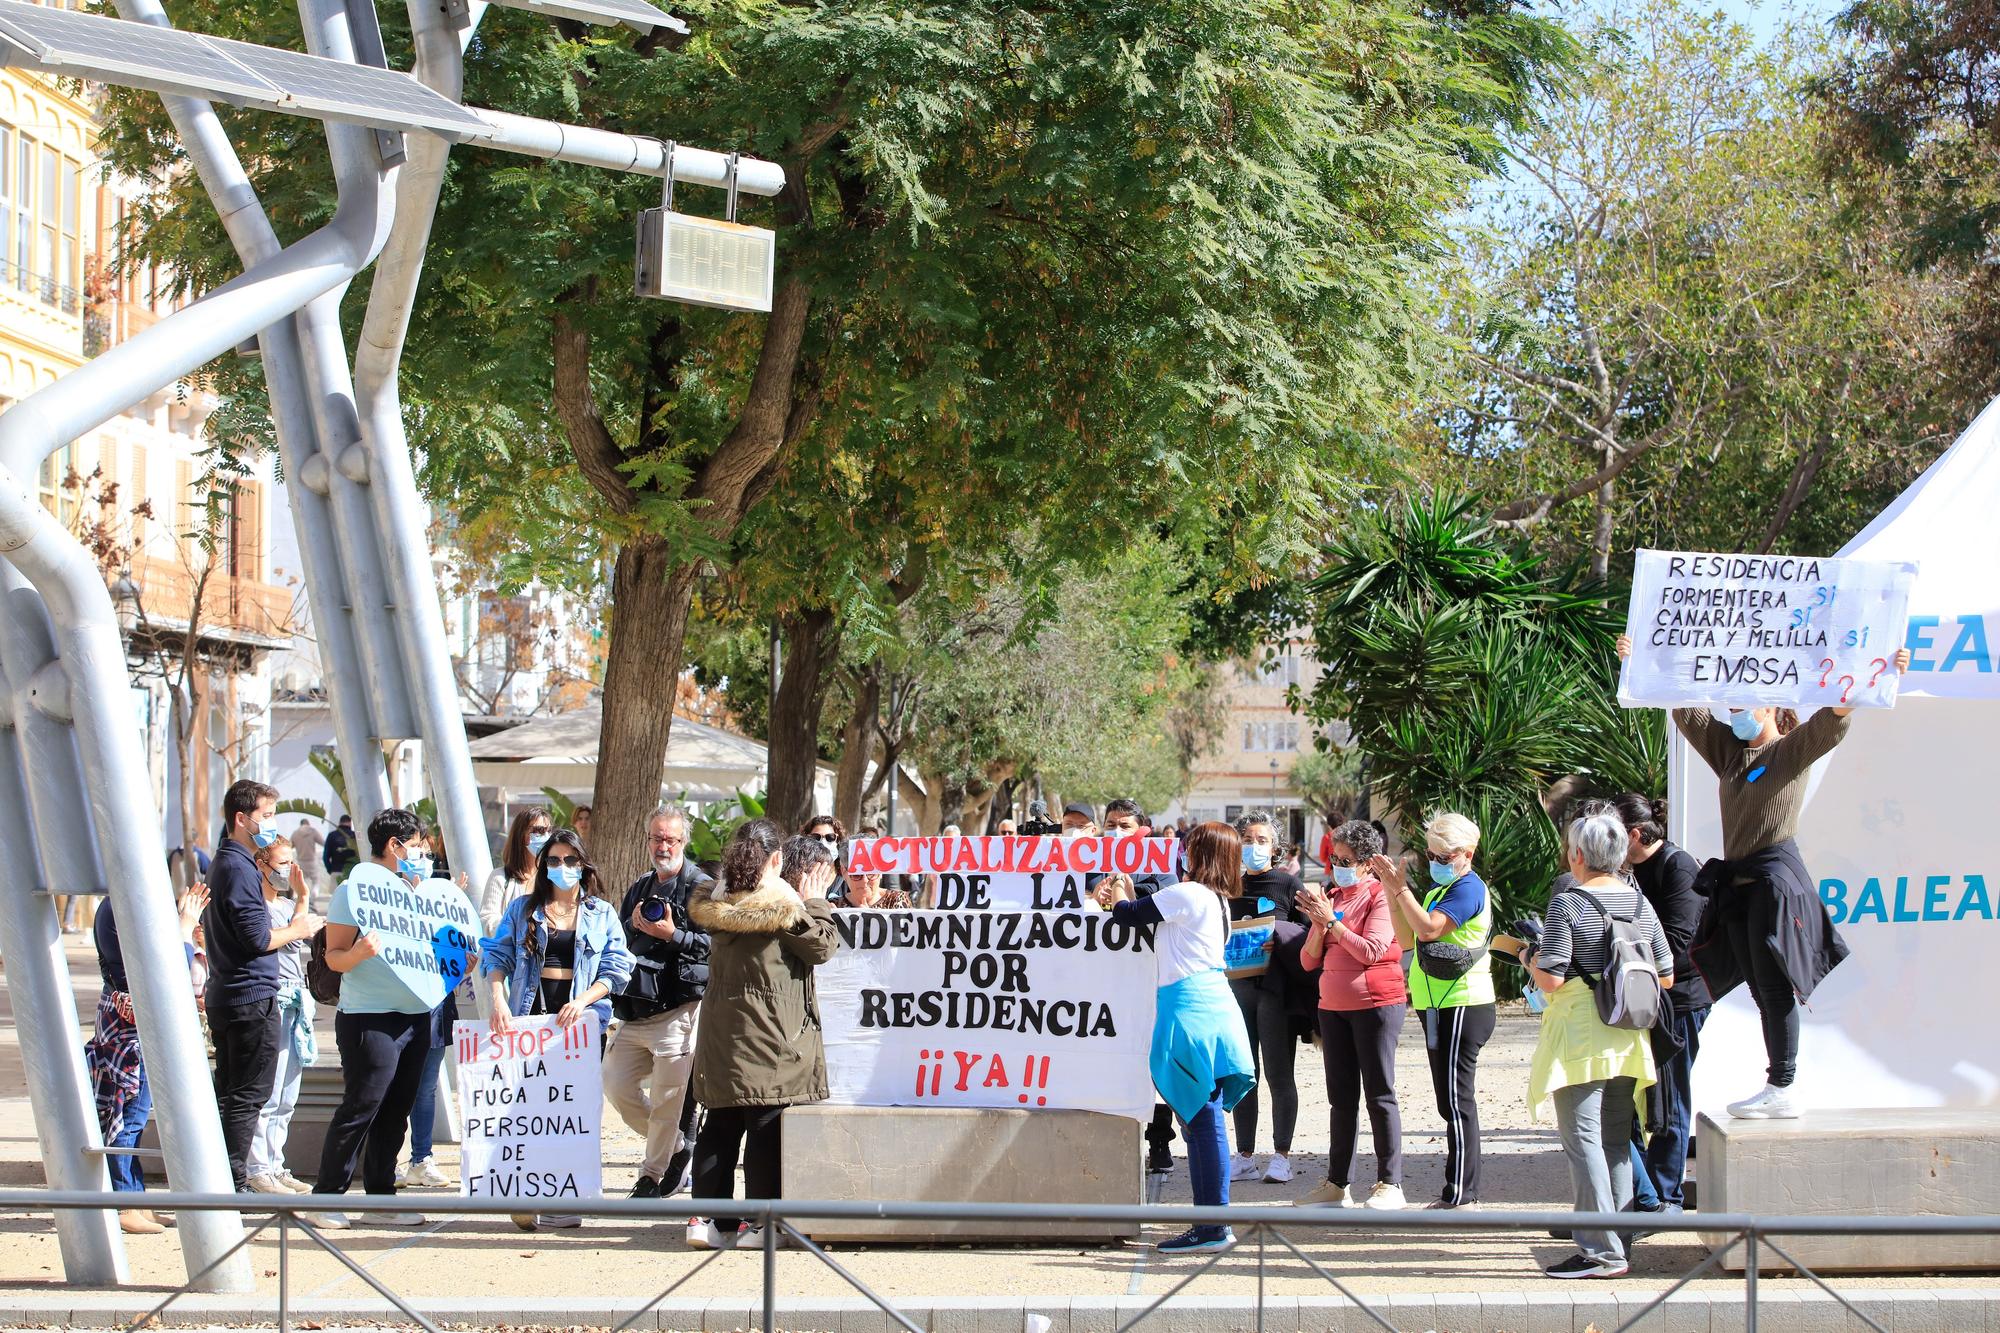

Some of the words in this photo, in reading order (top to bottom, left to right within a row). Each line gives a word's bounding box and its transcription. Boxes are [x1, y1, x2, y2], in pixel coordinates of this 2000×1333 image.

[1668, 556, 1821, 582] RESIDENCIA
[1661, 587, 1788, 608] FORMENTERA
[1651, 628, 1715, 648] CEUTA
[1726, 630, 1738, 648] Y
[1904, 614, 2000, 673] EA
[849, 826, 1172, 874] ACTUALIZACIÓN
[937, 874, 992, 911] DE
[1030, 872, 1082, 910] LA
[1816, 874, 2000, 924] BALEA
[447, 929, 478, 953] CON
[832, 911, 1157, 953] NDEMNIZACION
[941, 951, 1030, 993] POR
[860, 989, 1117, 1038] RESIDENCIA
[489, 1027, 554, 1060] STOP
[491, 1064, 503, 1081] A
[523, 1060, 547, 1079] LA
[474, 1087, 527, 1107] FUGA
[549, 1085, 574, 1104] DE
[468, 1115, 590, 1138] PERSONAL
[502, 1144, 525, 1162] DE
